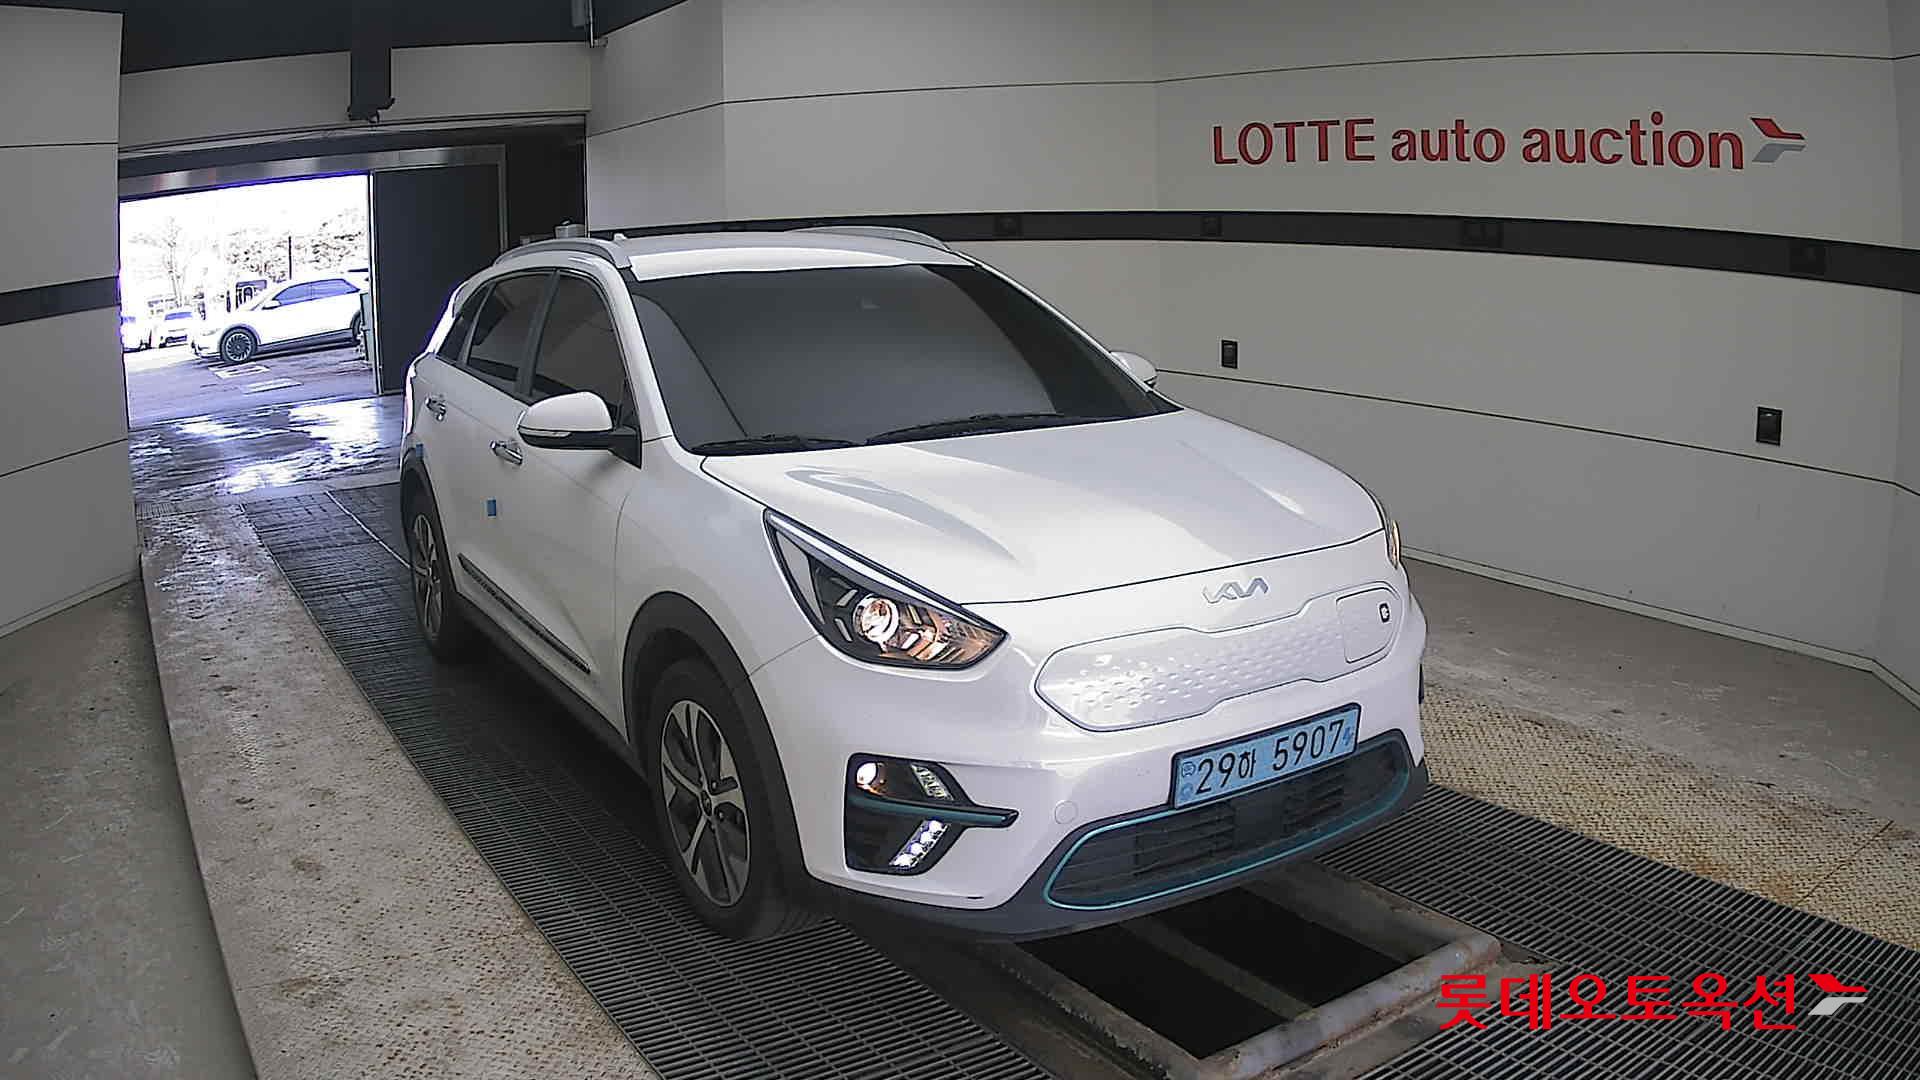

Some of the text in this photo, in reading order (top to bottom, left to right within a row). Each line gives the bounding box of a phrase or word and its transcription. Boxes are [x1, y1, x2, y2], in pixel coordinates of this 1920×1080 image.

[1212, 111, 1745, 171] LOTTE auto auction
[1195, 718, 1345, 796] 29하 5907
